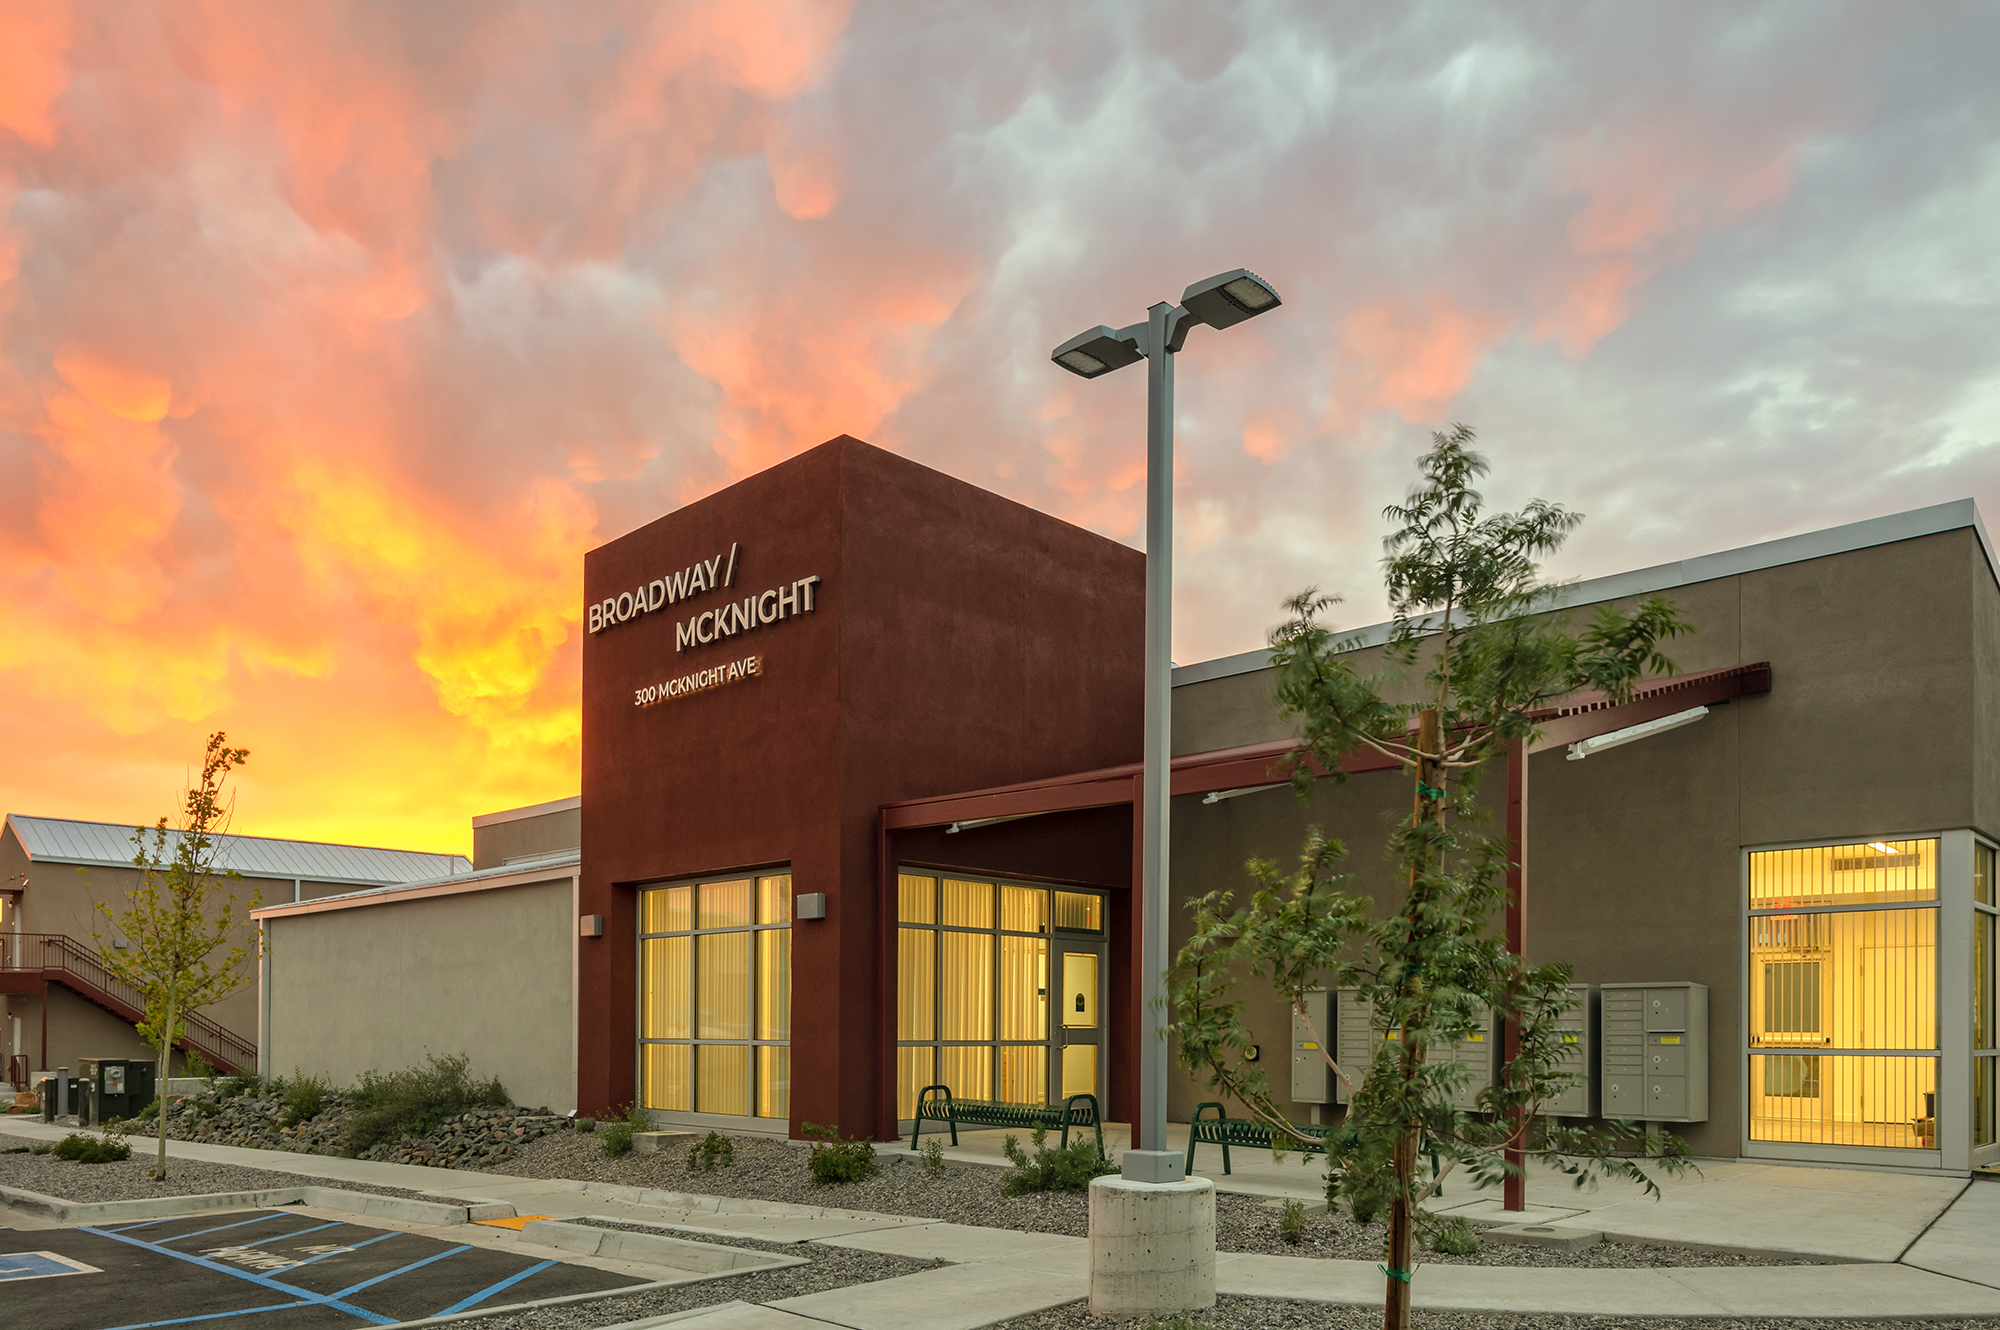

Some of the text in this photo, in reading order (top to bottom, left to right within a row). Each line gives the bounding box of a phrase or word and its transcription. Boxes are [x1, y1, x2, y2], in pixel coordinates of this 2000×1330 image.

[676, 575, 819, 652] MCKNIGHT
[634, 656, 757, 706] 300 MCKNIGHT AVE
